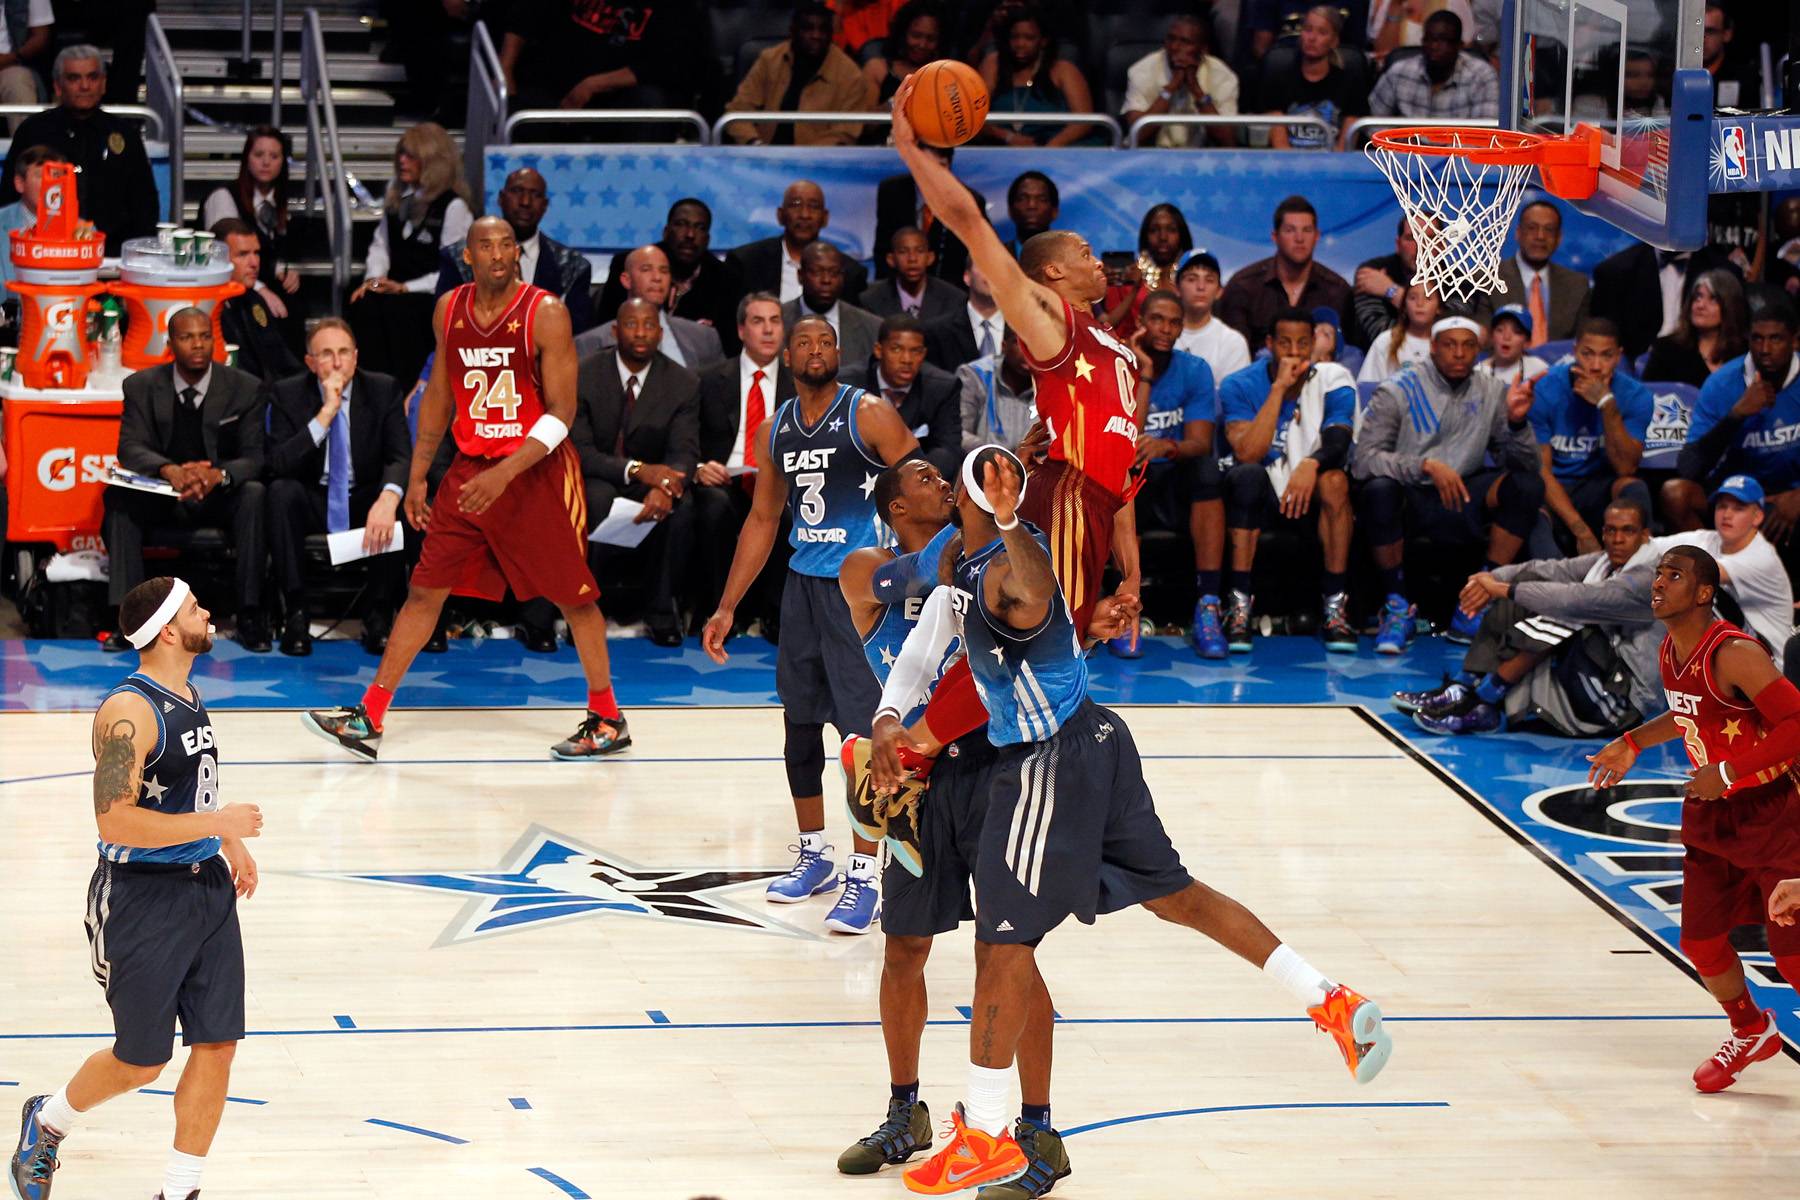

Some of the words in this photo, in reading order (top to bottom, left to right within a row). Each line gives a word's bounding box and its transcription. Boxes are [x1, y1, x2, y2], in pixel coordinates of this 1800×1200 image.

[1727, 167, 1741, 176] NBA
[47, 302, 74, 330] G
[458, 347, 516, 368] WEST
[463, 369, 522, 421] 24
[1114, 356, 1137, 418] 0
[1144, 407, 1184, 430] STAR
[783, 447, 837, 473] EAST
[795, 472, 826, 527] 3
[180, 725, 217, 757] EAS
[1673, 715, 1709, 768] 3
[194, 753, 218, 813] 8
